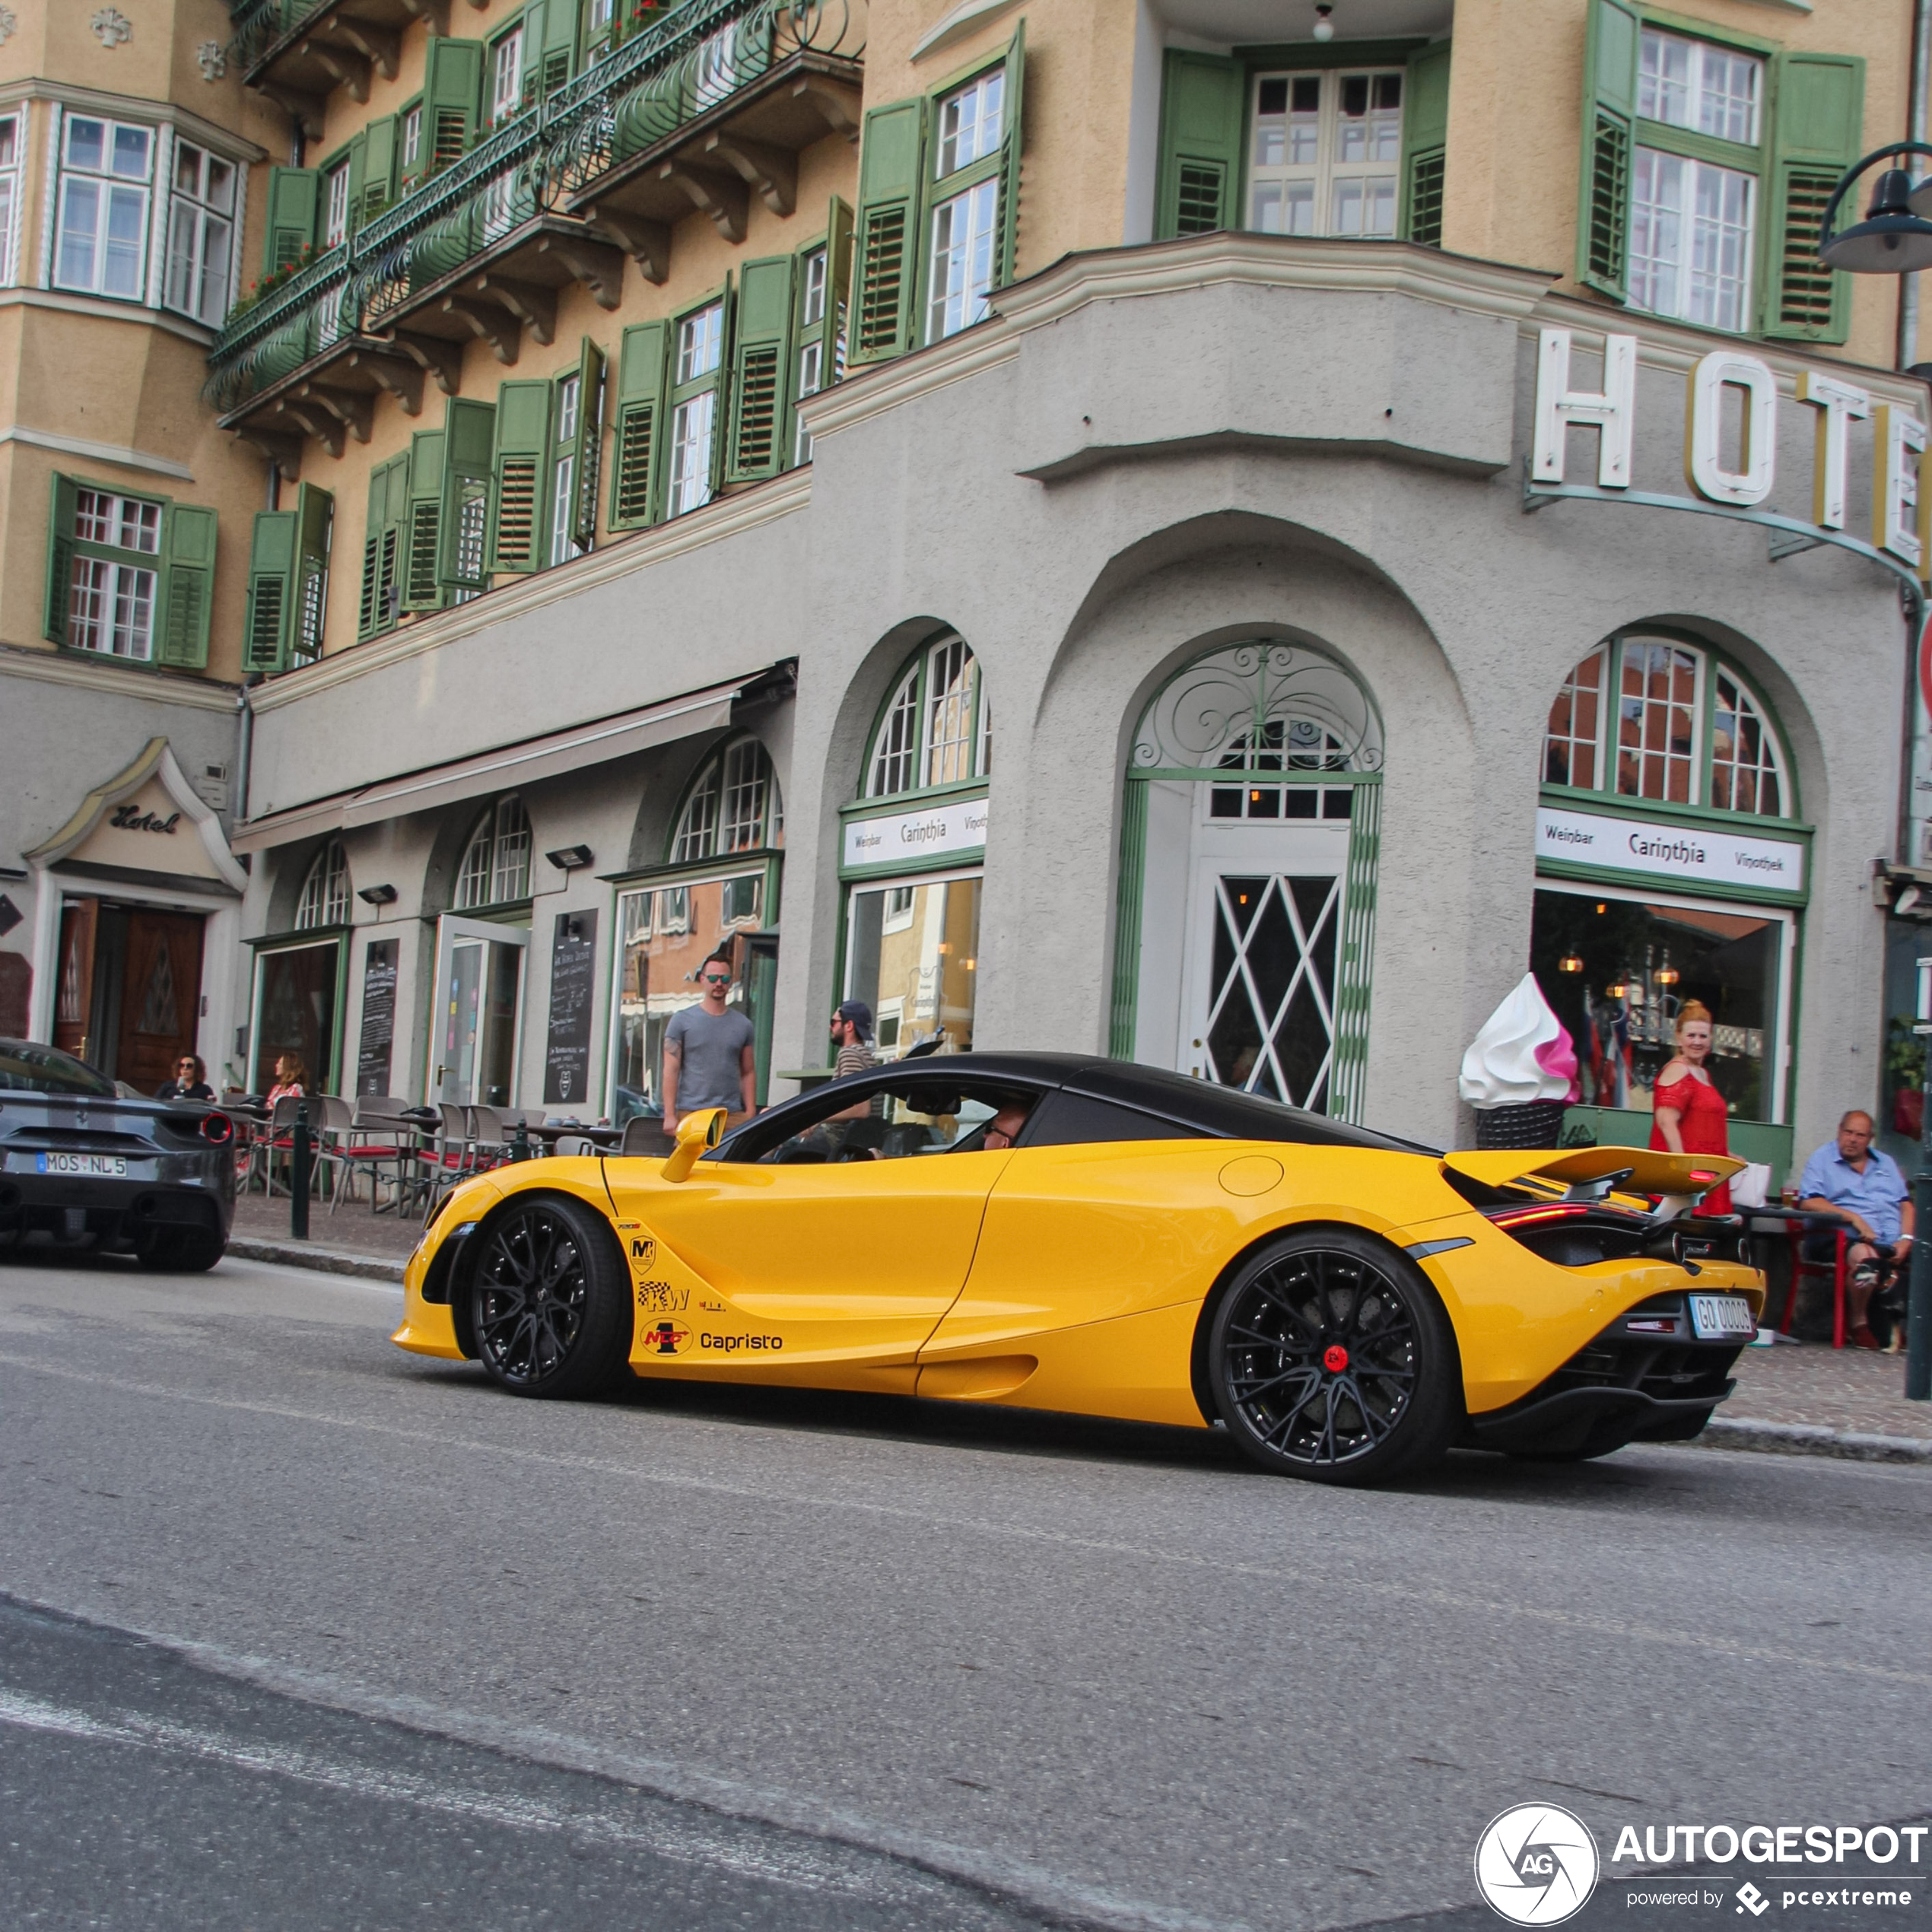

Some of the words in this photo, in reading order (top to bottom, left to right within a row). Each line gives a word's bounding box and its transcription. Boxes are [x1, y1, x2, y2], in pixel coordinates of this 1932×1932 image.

[1531, 329, 1932, 583] HOTE
[110, 806, 180, 834] Hotel
[855, 834, 882, 848] Weinbar
[901, 818, 946, 843] Carinthia
[1545, 825, 1594, 845] Weinbar
[1629, 833, 1705, 864] Carinthia
[1735, 851, 1784, 872] Vinothek
[47, 1155, 79, 1171] MOS
[91, 1157, 112, 1174] NL
[115, 1158, 126, 1174] 5
[647, 1289, 690, 1312] KW
[1698, 1299, 1716, 1330] GO
[701, 1333, 783, 1352] Capristo
